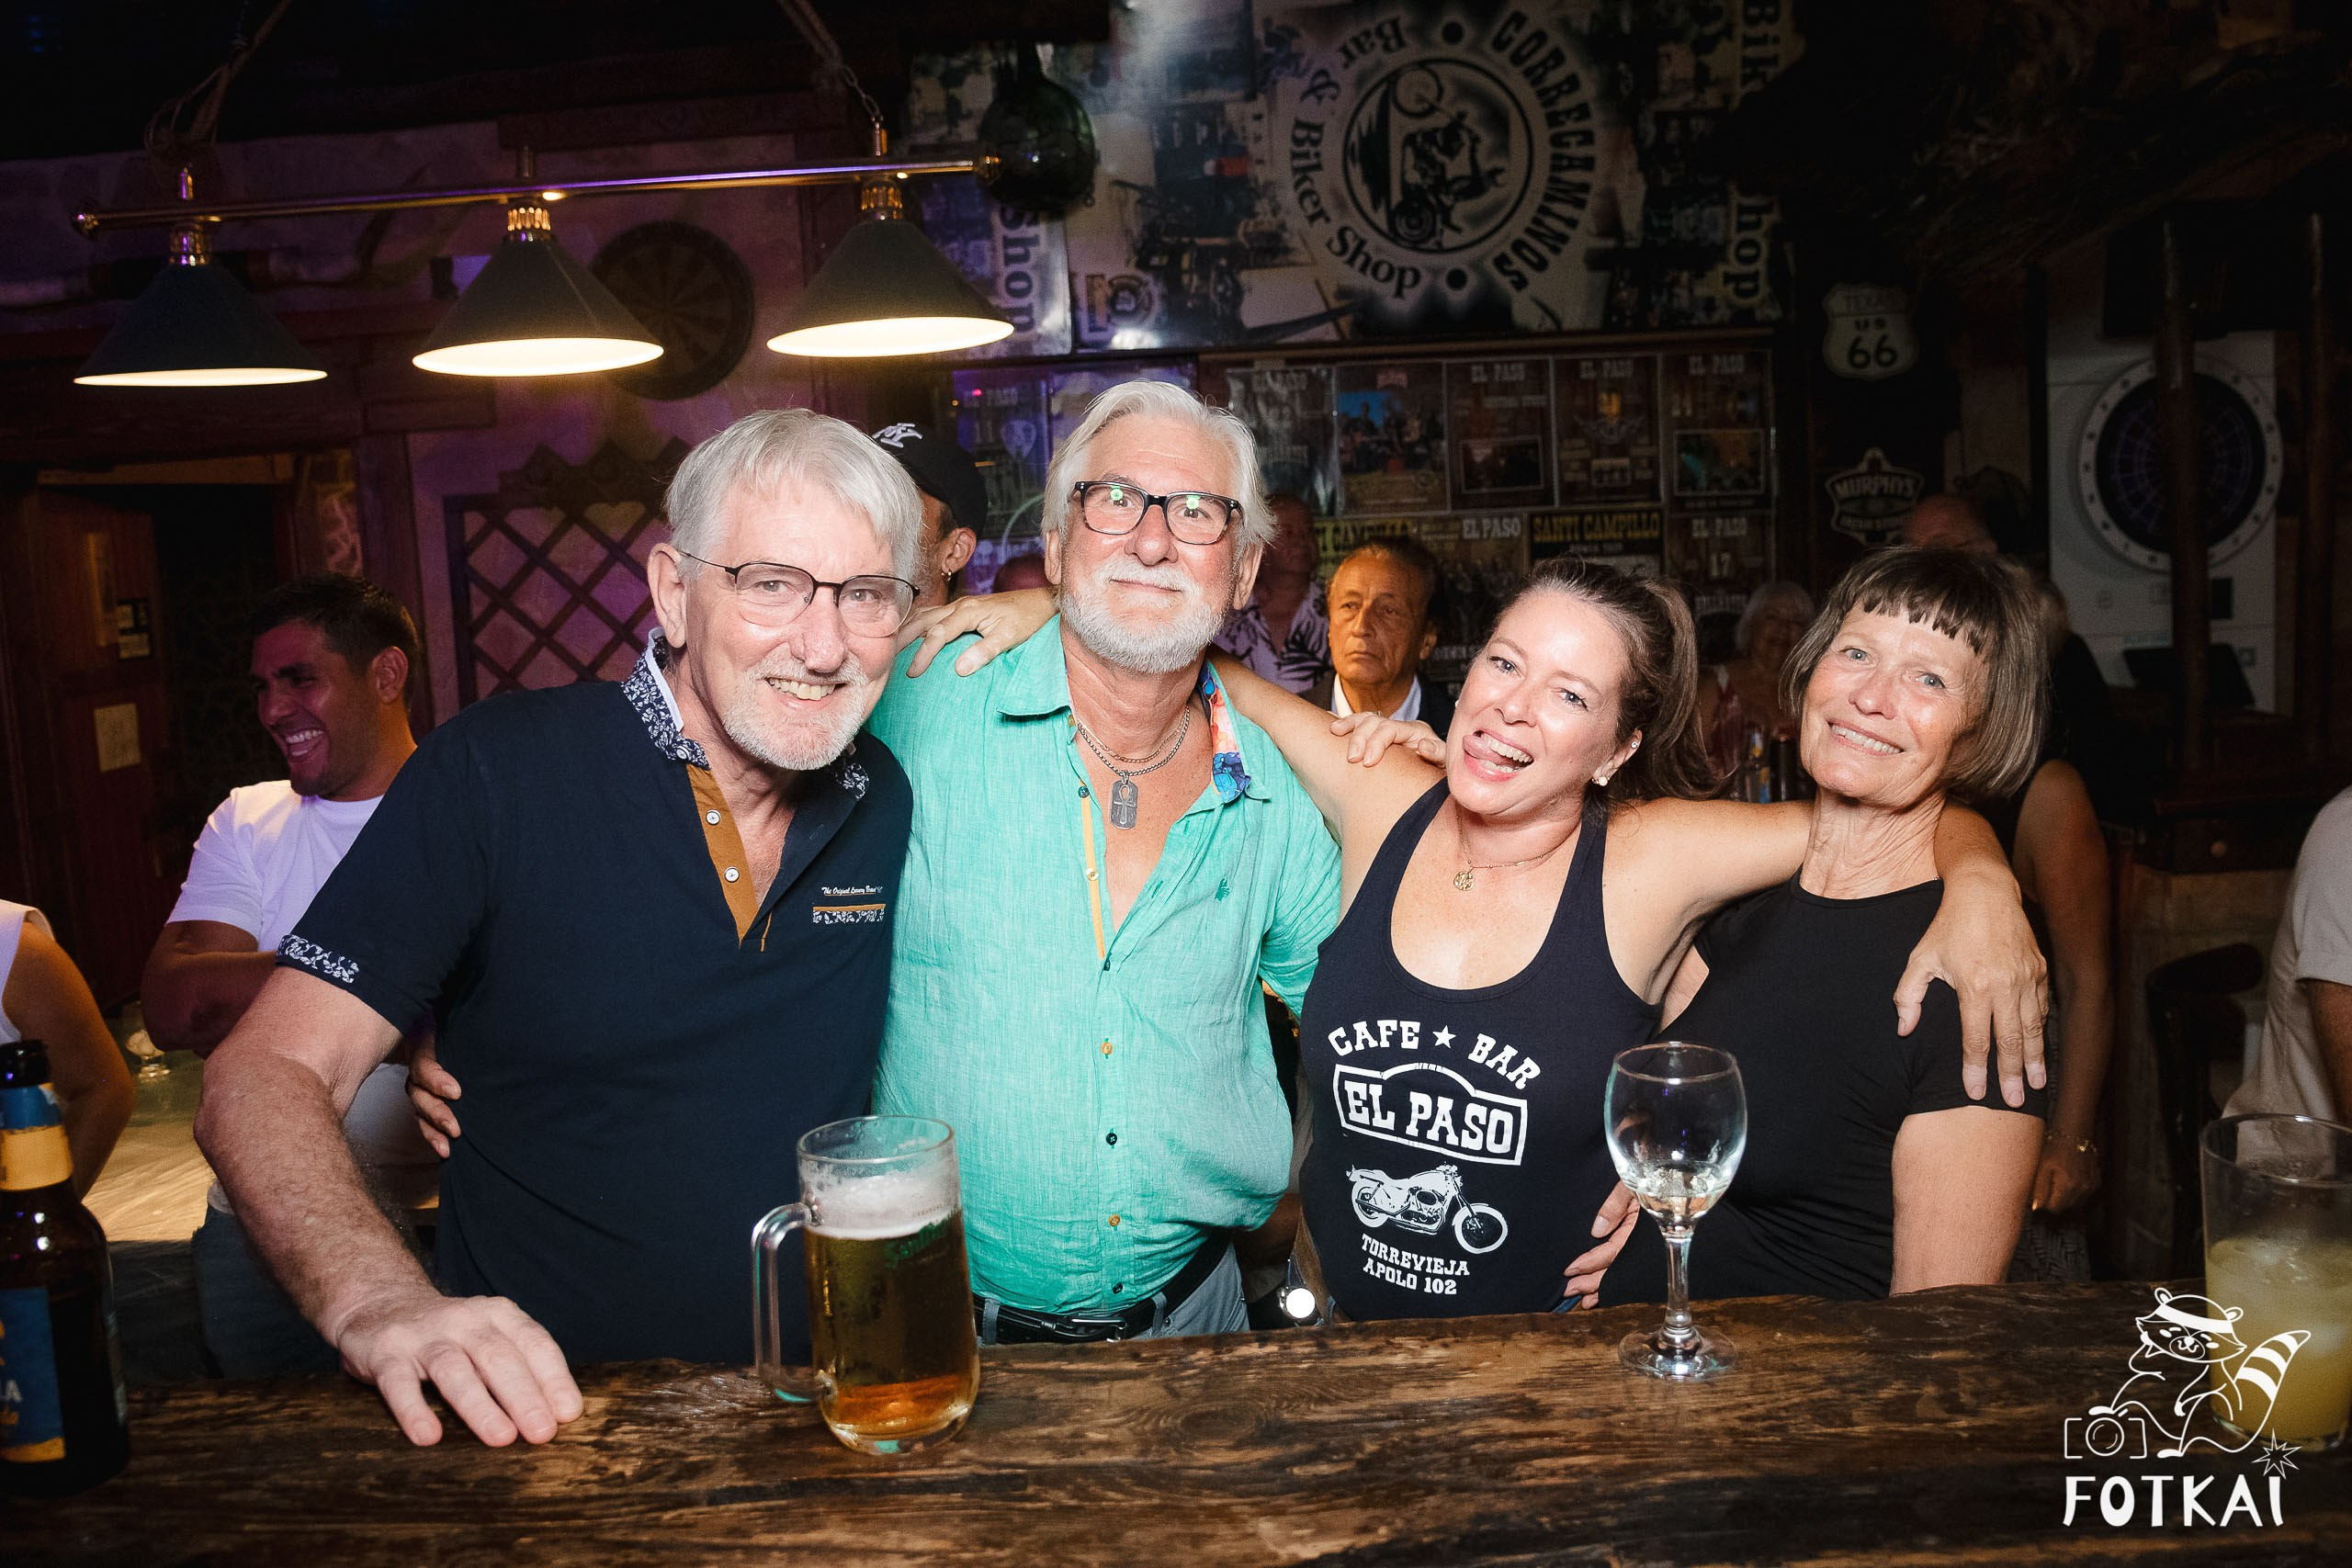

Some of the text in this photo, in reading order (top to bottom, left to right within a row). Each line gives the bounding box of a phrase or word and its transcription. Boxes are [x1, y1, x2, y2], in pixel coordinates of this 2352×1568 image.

[1290, 17, 1421, 299] Bar & Biker Shop
[1492, 11, 1595, 291] CORRECAMINOS
[1724, 198, 1772, 299] hop
[1854, 318, 1886, 331] US
[1579, 359, 1596, 379] EL
[1848, 334, 1897, 368] 66
[1471, 363, 1488, 383] EL
[1462, 517, 1480, 539] EL
[1482, 515, 1522, 538] PASO
[1532, 512, 1659, 543] SANTI CAMPILLO
[1328, 1019, 1542, 1090] CAFE BAR
[1344, 1080, 1515, 1154] EL PASO
[1361, 1233, 1471, 1276] TORREVIEJA
[1363, 1258, 1458, 1295] APOLO 102
